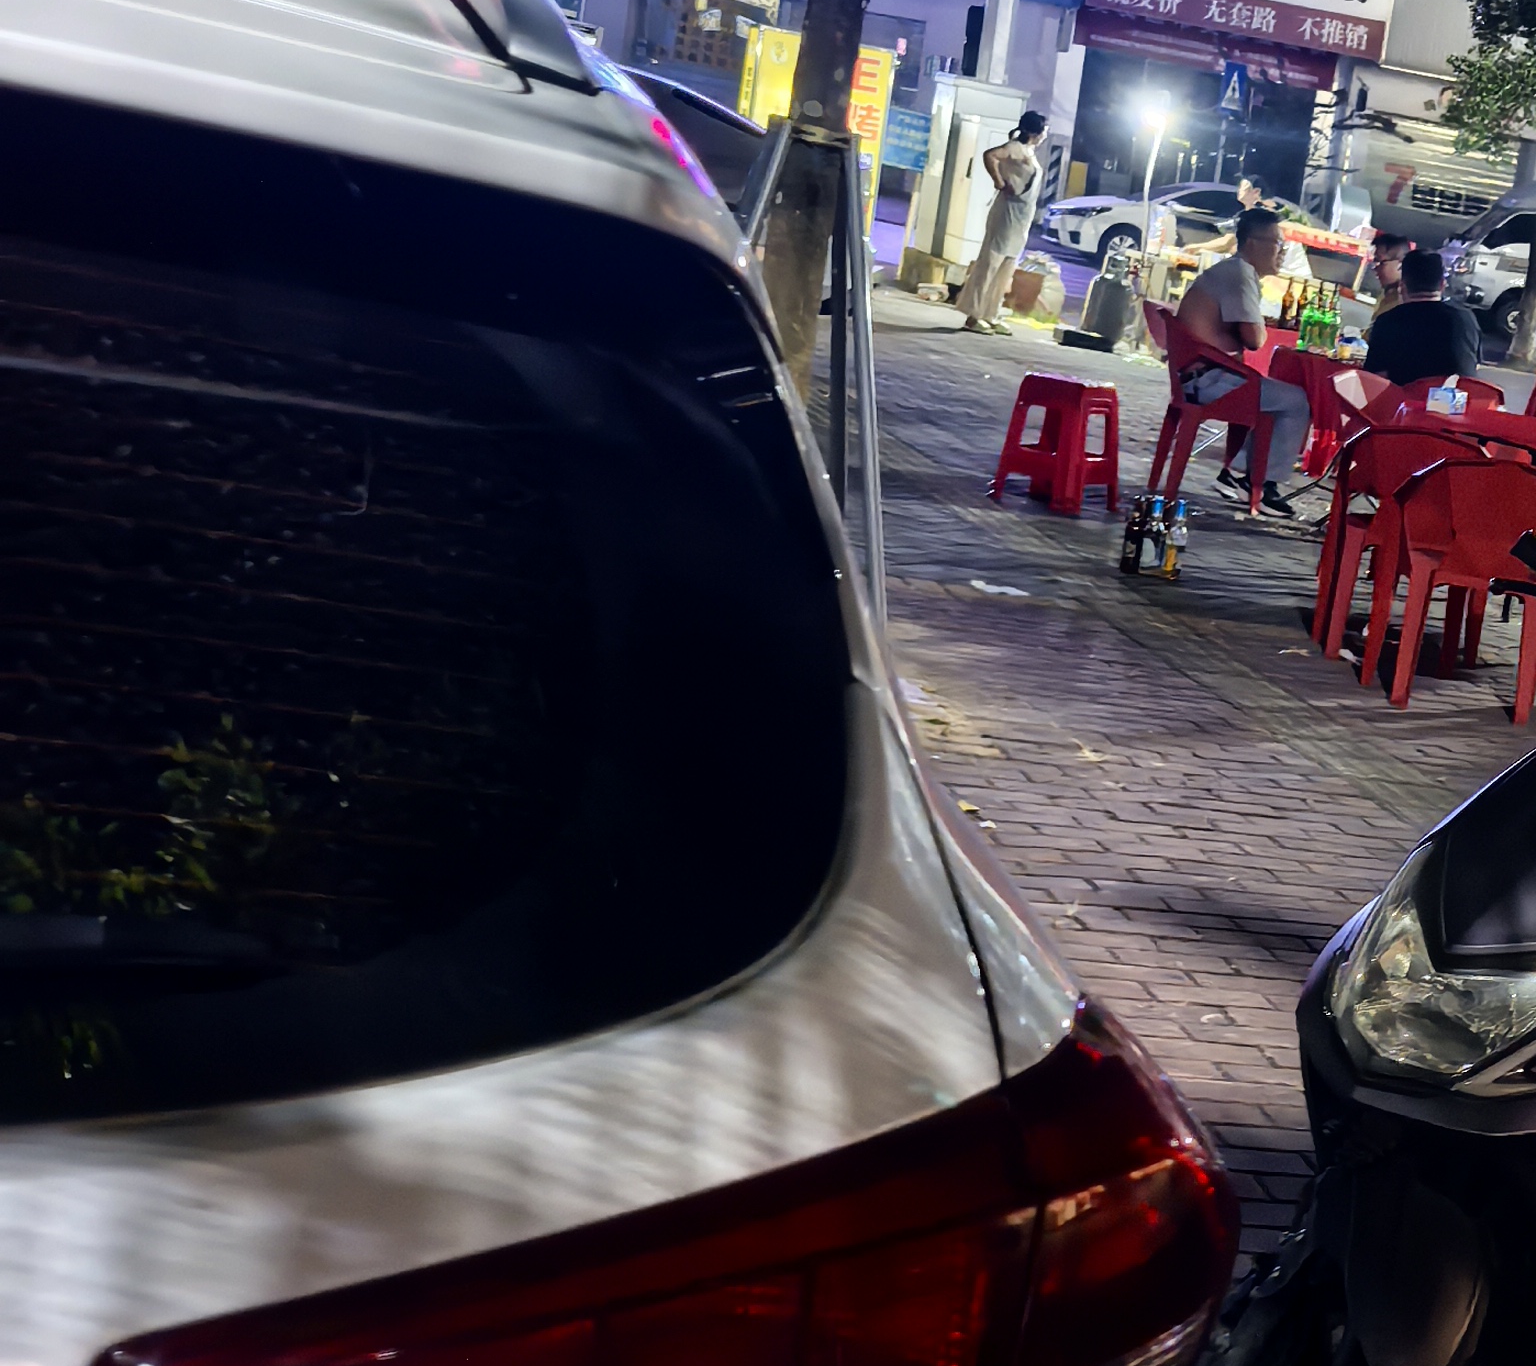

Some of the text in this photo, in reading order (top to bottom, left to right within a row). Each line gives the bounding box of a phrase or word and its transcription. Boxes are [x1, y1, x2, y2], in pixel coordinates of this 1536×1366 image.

[1203, 0, 1277, 33] 无套路
[1298, 16, 1369, 51] 不推销
